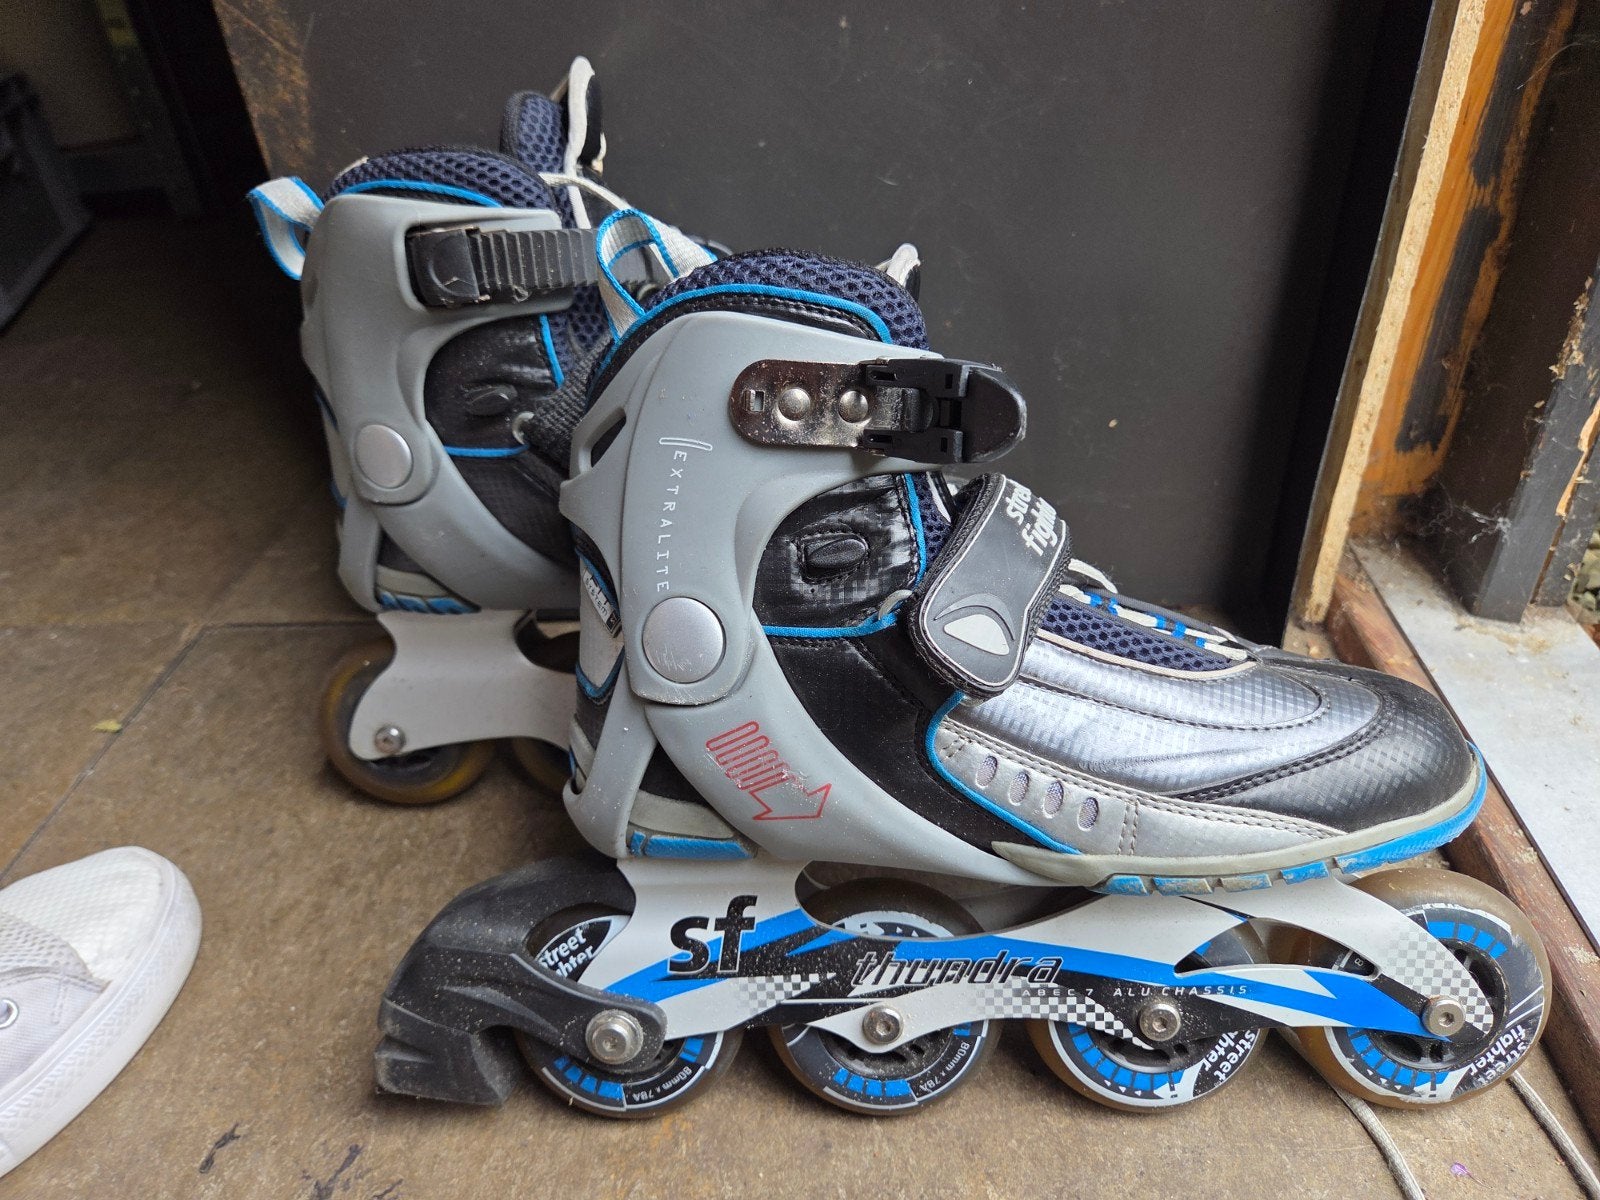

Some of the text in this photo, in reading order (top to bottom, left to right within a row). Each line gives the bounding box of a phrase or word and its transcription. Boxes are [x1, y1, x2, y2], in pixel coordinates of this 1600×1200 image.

[656, 450, 687, 592] EXTRALITE
[1005, 486, 1032, 525] stre
[1021, 497, 1057, 556] fight
[667, 895, 758, 974] sf
[851, 949, 1063, 986] thundra
[1022, 985, 1248, 997] ABEC 7 ALU CHASSIS
[945, 1041, 970, 1071] 80mm
[1213, 1030, 1256, 1082] street
[1468, 1024, 1526, 1076] fighter
[632, 1090, 655, 1102] 78A
[662, 1065, 693, 1090] 80mm
[919, 1074, 941, 1092] 78A
